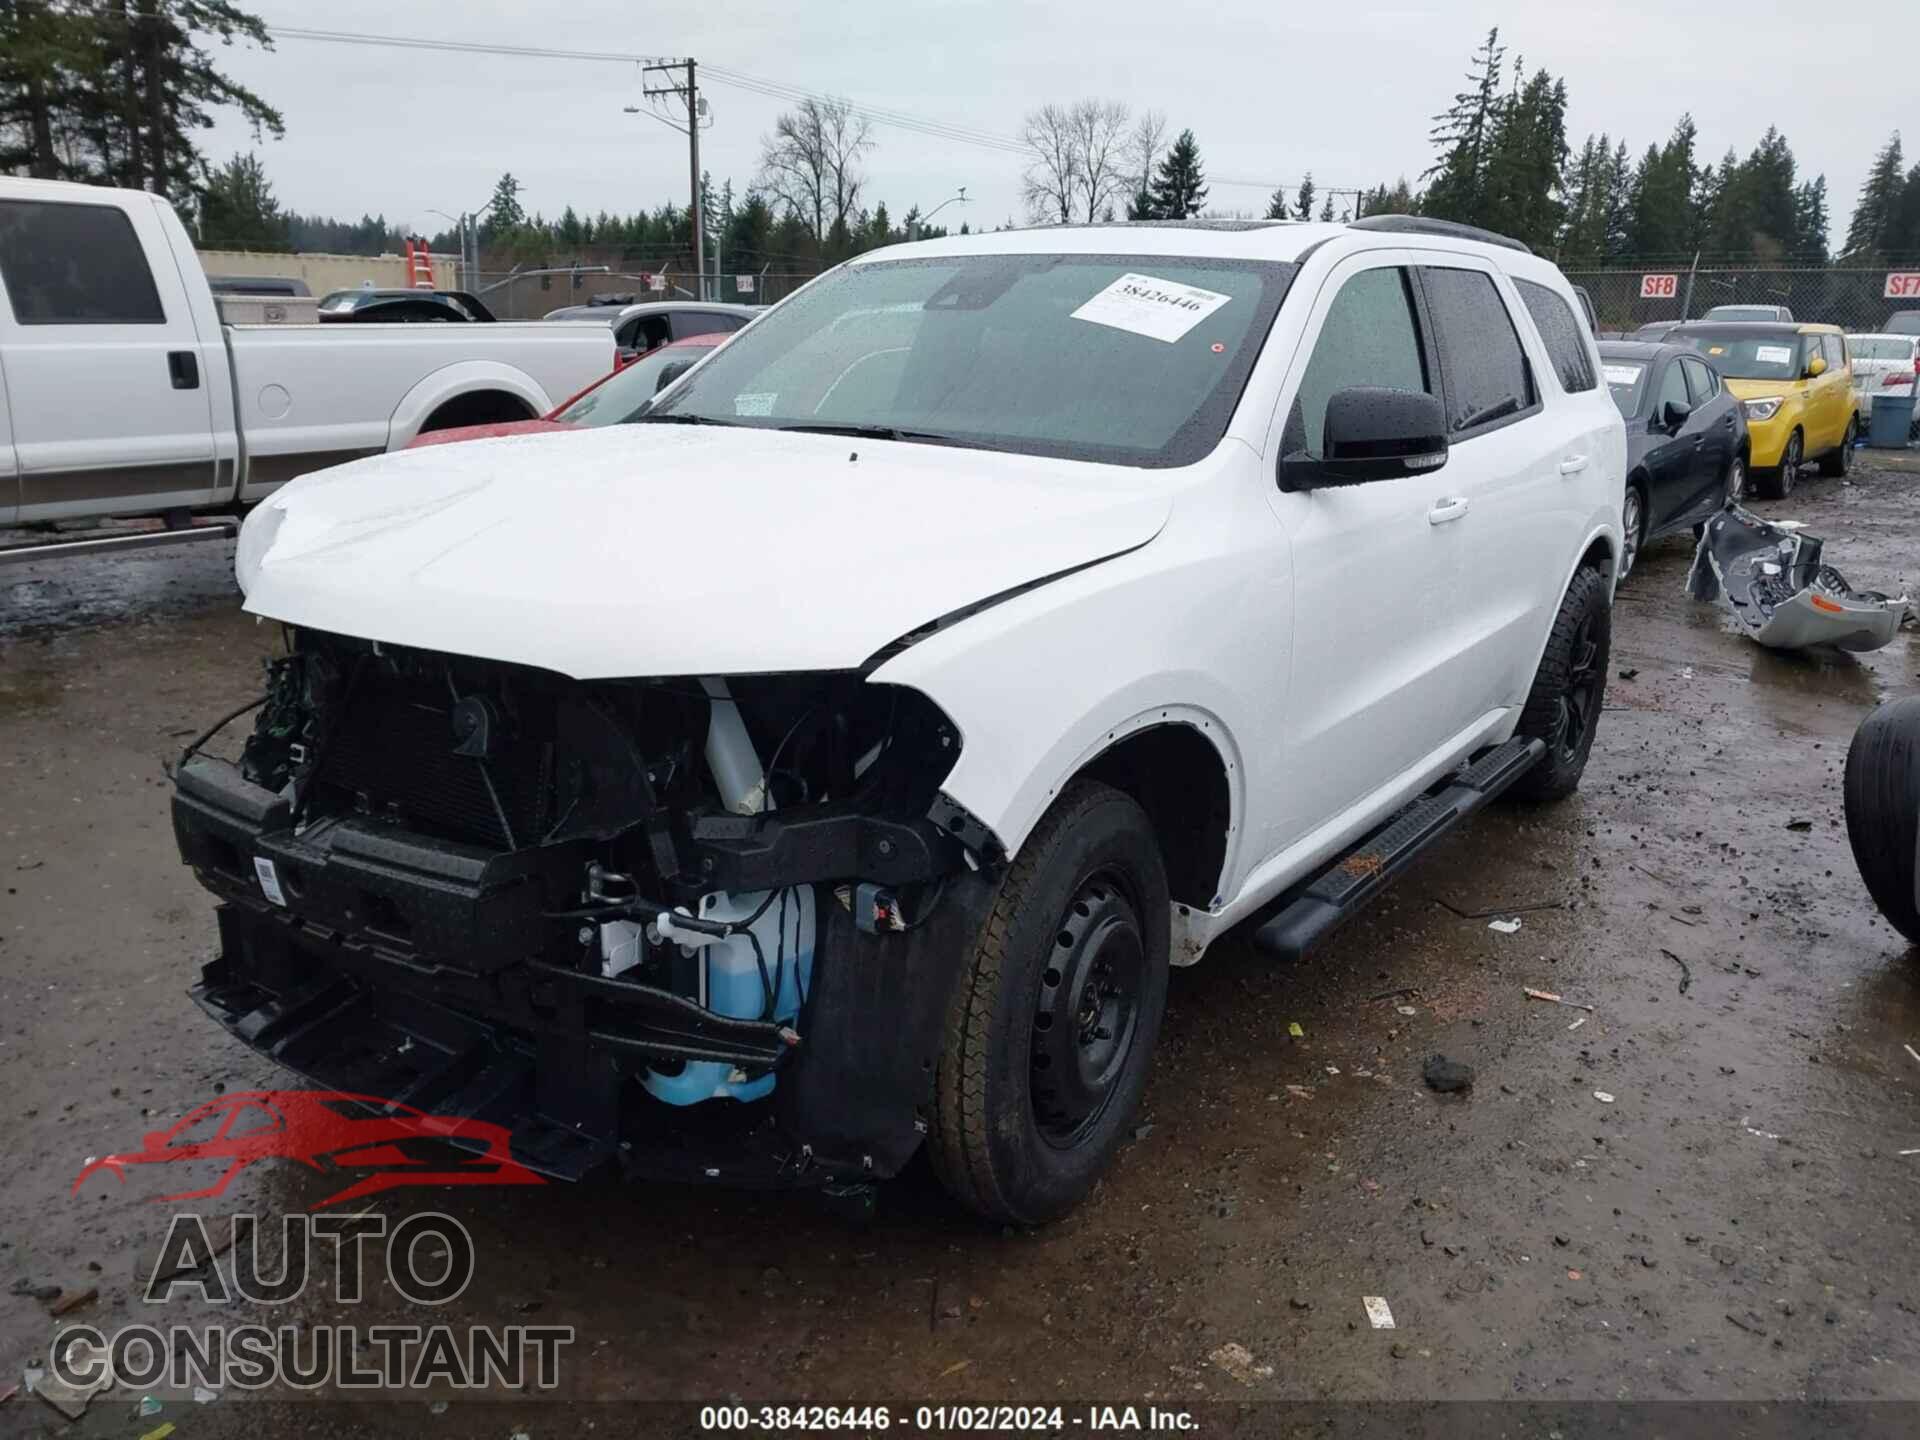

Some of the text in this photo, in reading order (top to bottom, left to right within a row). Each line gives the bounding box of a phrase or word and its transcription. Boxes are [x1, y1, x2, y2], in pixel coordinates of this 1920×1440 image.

[1644, 276, 1674, 295] SF8
[1890, 275, 1920, 295] SF7
[1117, 285, 1200, 311] 38426446
